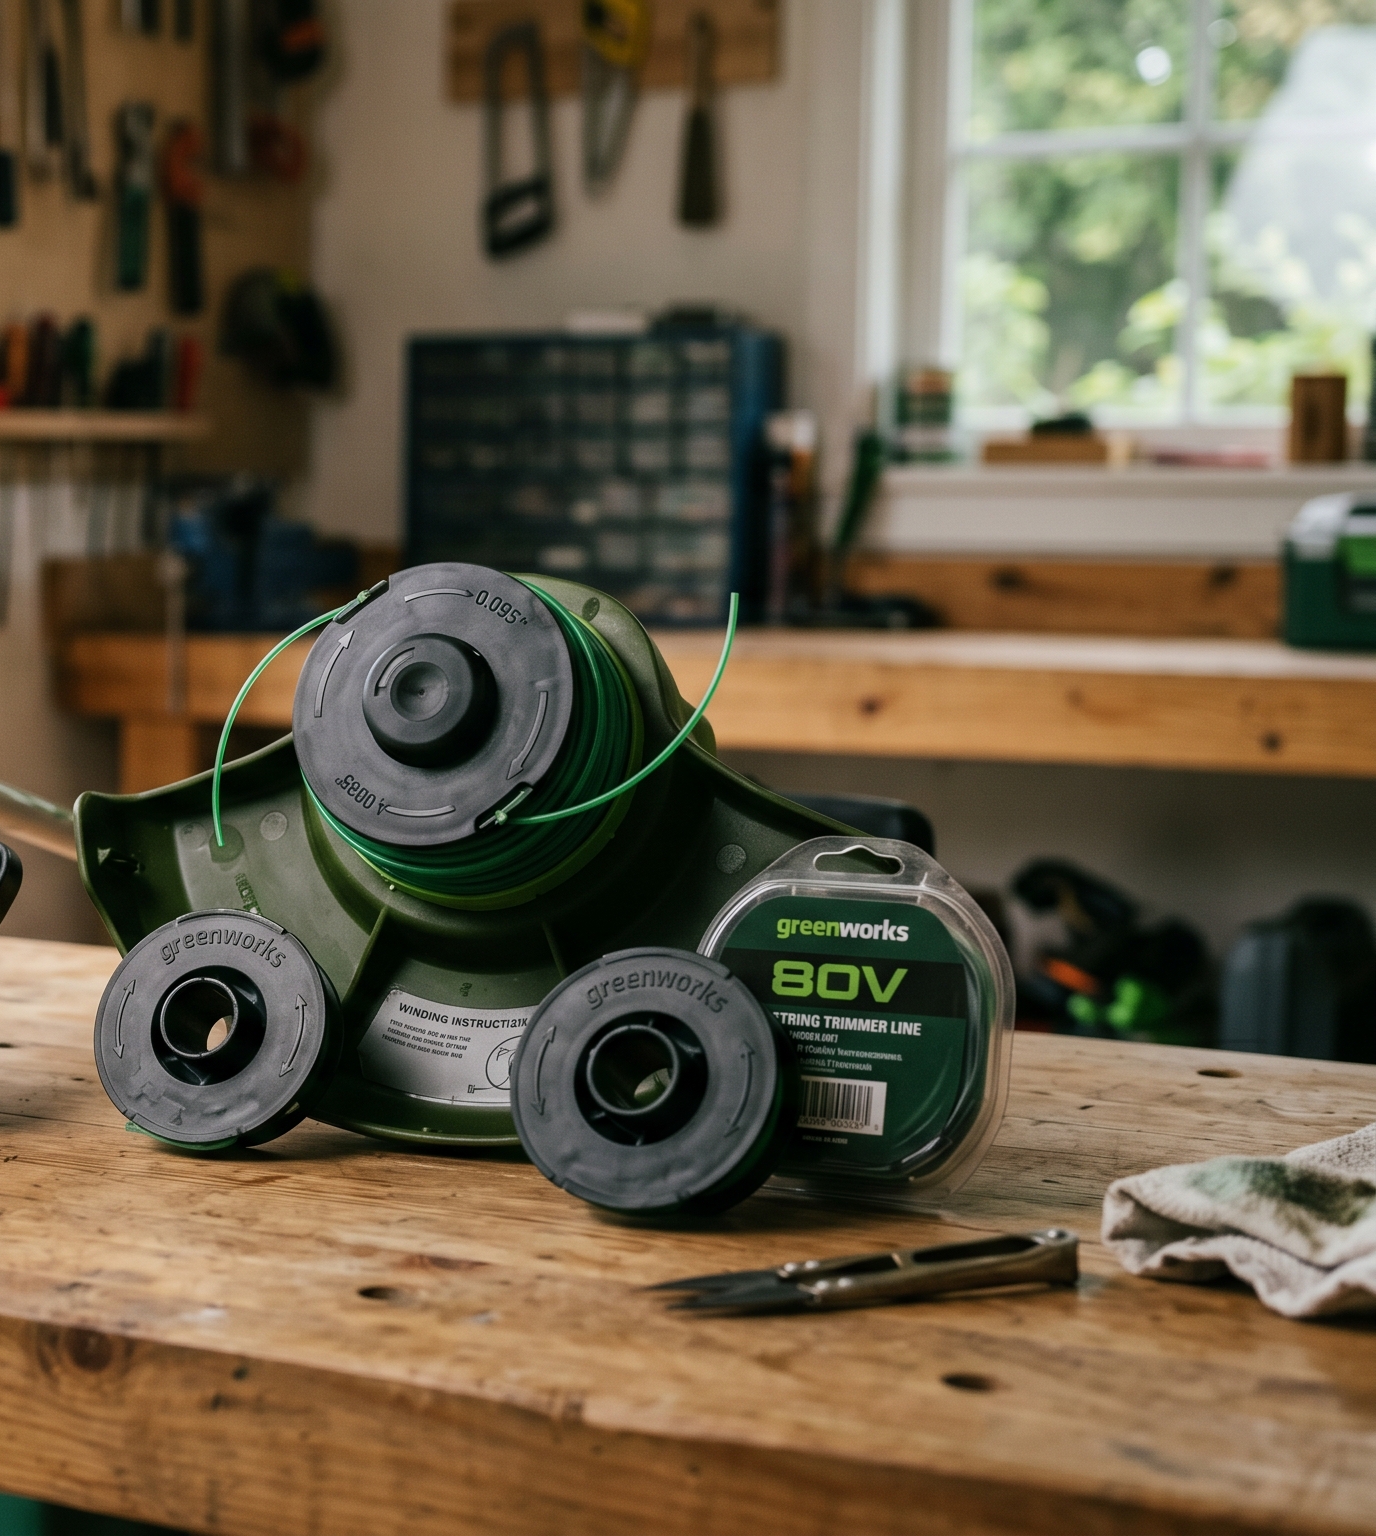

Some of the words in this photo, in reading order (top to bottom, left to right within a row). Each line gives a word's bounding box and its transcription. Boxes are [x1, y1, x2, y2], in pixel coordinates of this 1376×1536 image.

[776, 918, 909, 942] greenworks
[159, 928, 286, 968] greenworks
[586, 969, 729, 1014] greenworks
[771, 960, 908, 1003] 80V
[399, 1002, 449, 1024] WINDING
[823, 1015, 888, 1033] TRIMMER
[890, 1020, 922, 1036] LINE
